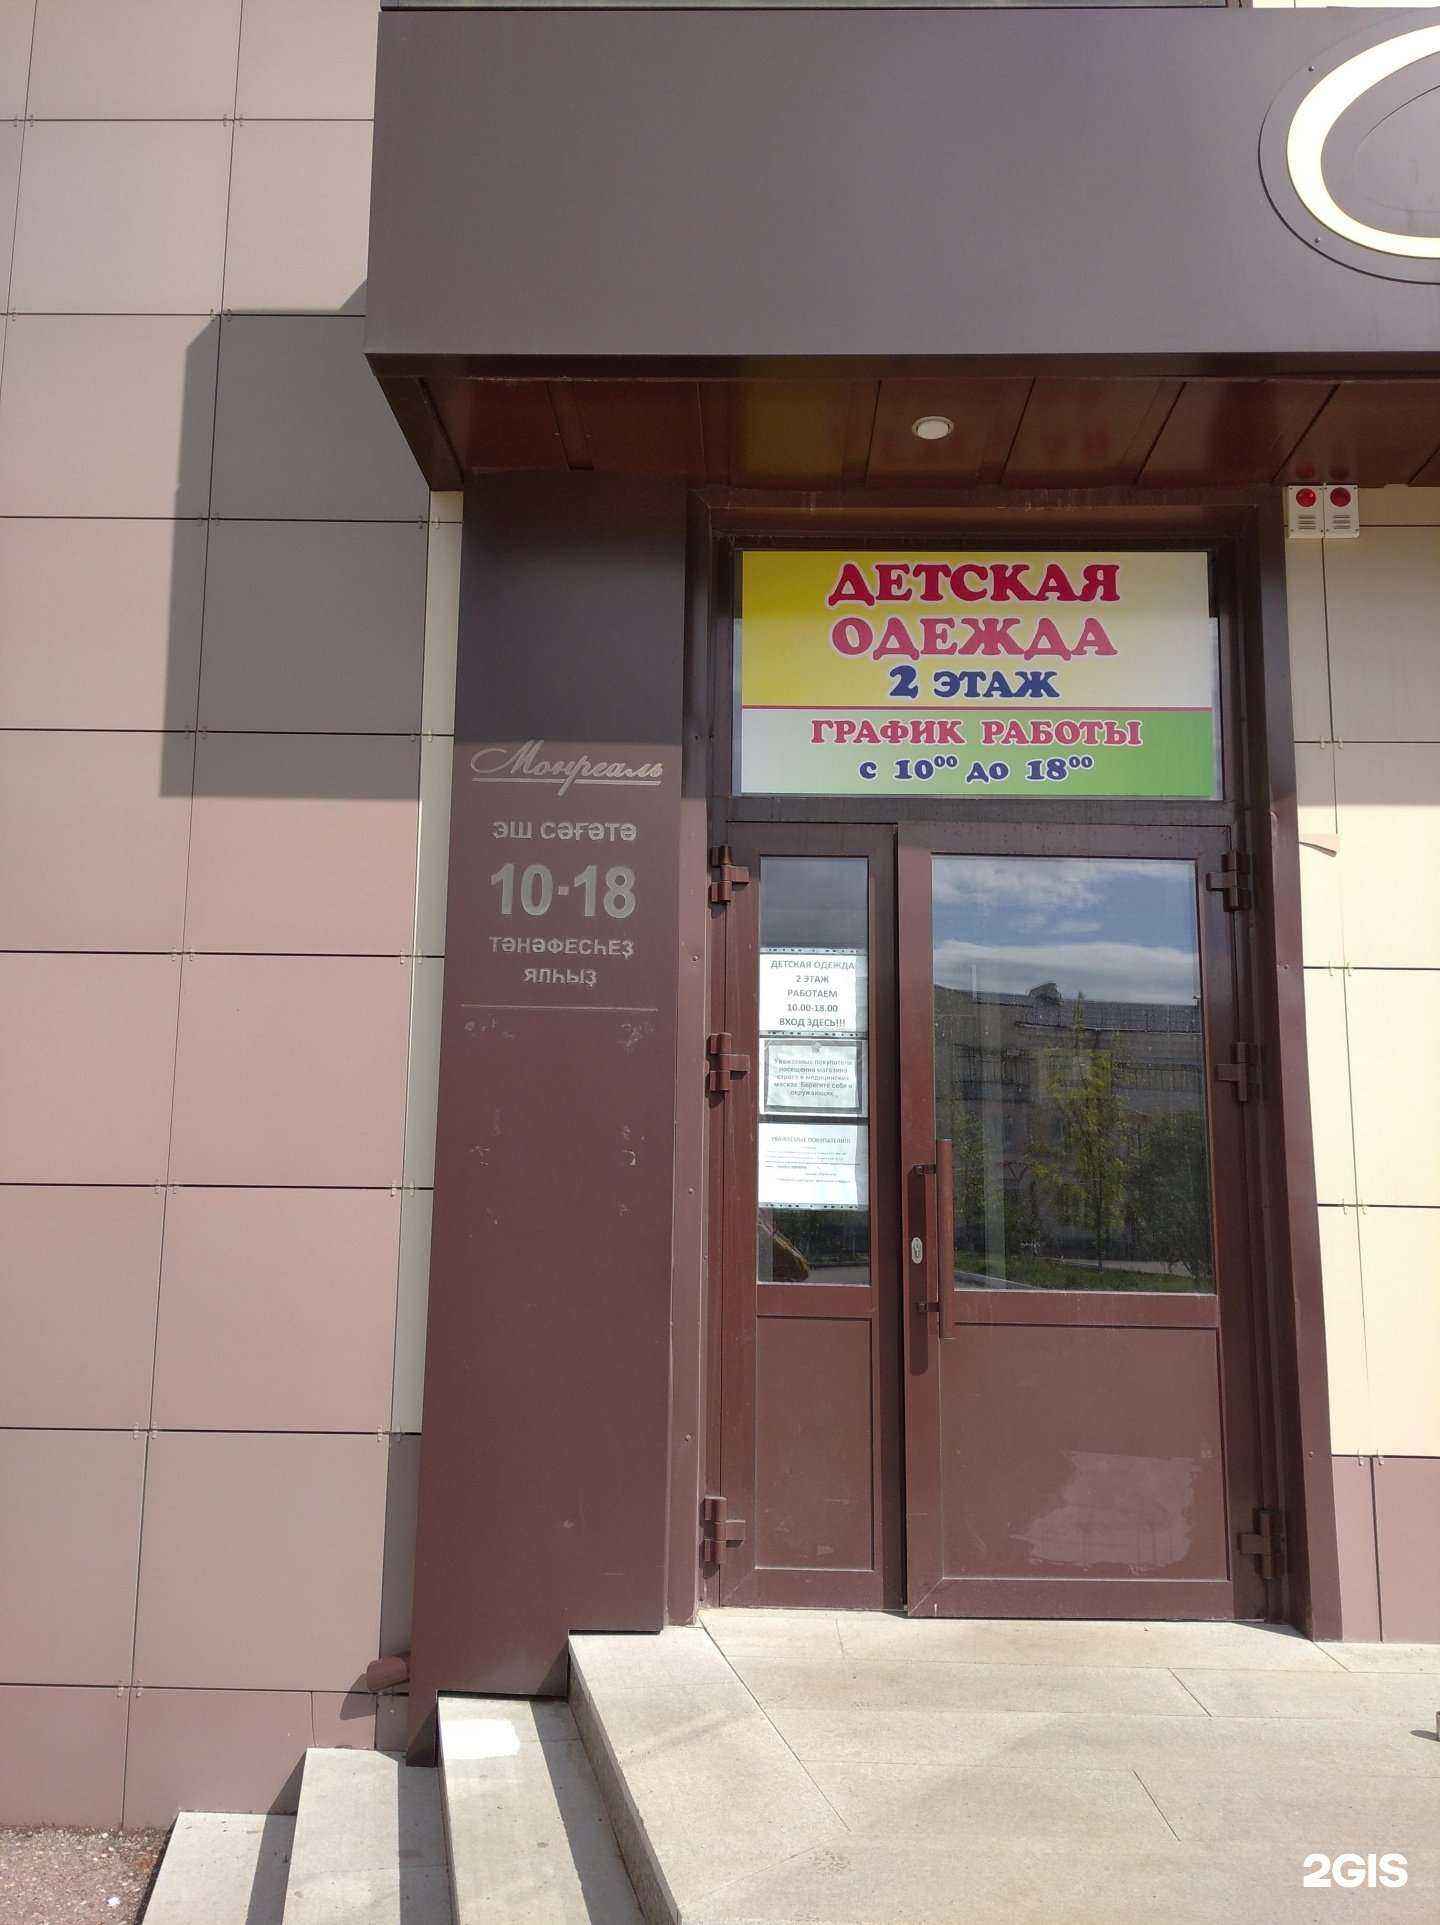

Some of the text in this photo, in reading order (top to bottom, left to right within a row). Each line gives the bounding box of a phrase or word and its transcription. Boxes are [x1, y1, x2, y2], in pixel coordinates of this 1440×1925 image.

[828, 564, 1121, 607] ДЕТСКАЯ
[831, 617, 1118, 661] ОДЕЖДА
[888, 665, 1060, 699] 2 ЭТАЖ
[810, 719, 1143, 746] ГРАФИК РАБОТЫ
[470, 739, 664, 797] Монреаль
[492, 820, 532, 840] ЭШ
[490, 862, 637, 920] 10-18
[770, 959, 855, 971] ДЕТСКАЯ ОДЕЖДА
[796, 974, 830, 984] 2 ЭТАЖ
[787, 988, 838, 998] РАБОТАЕМ
[787, 1003, 838, 1013] 10.00-18.00
[779, 1017, 846, 1029] ВХОД ЗДЕСЬ!!!
